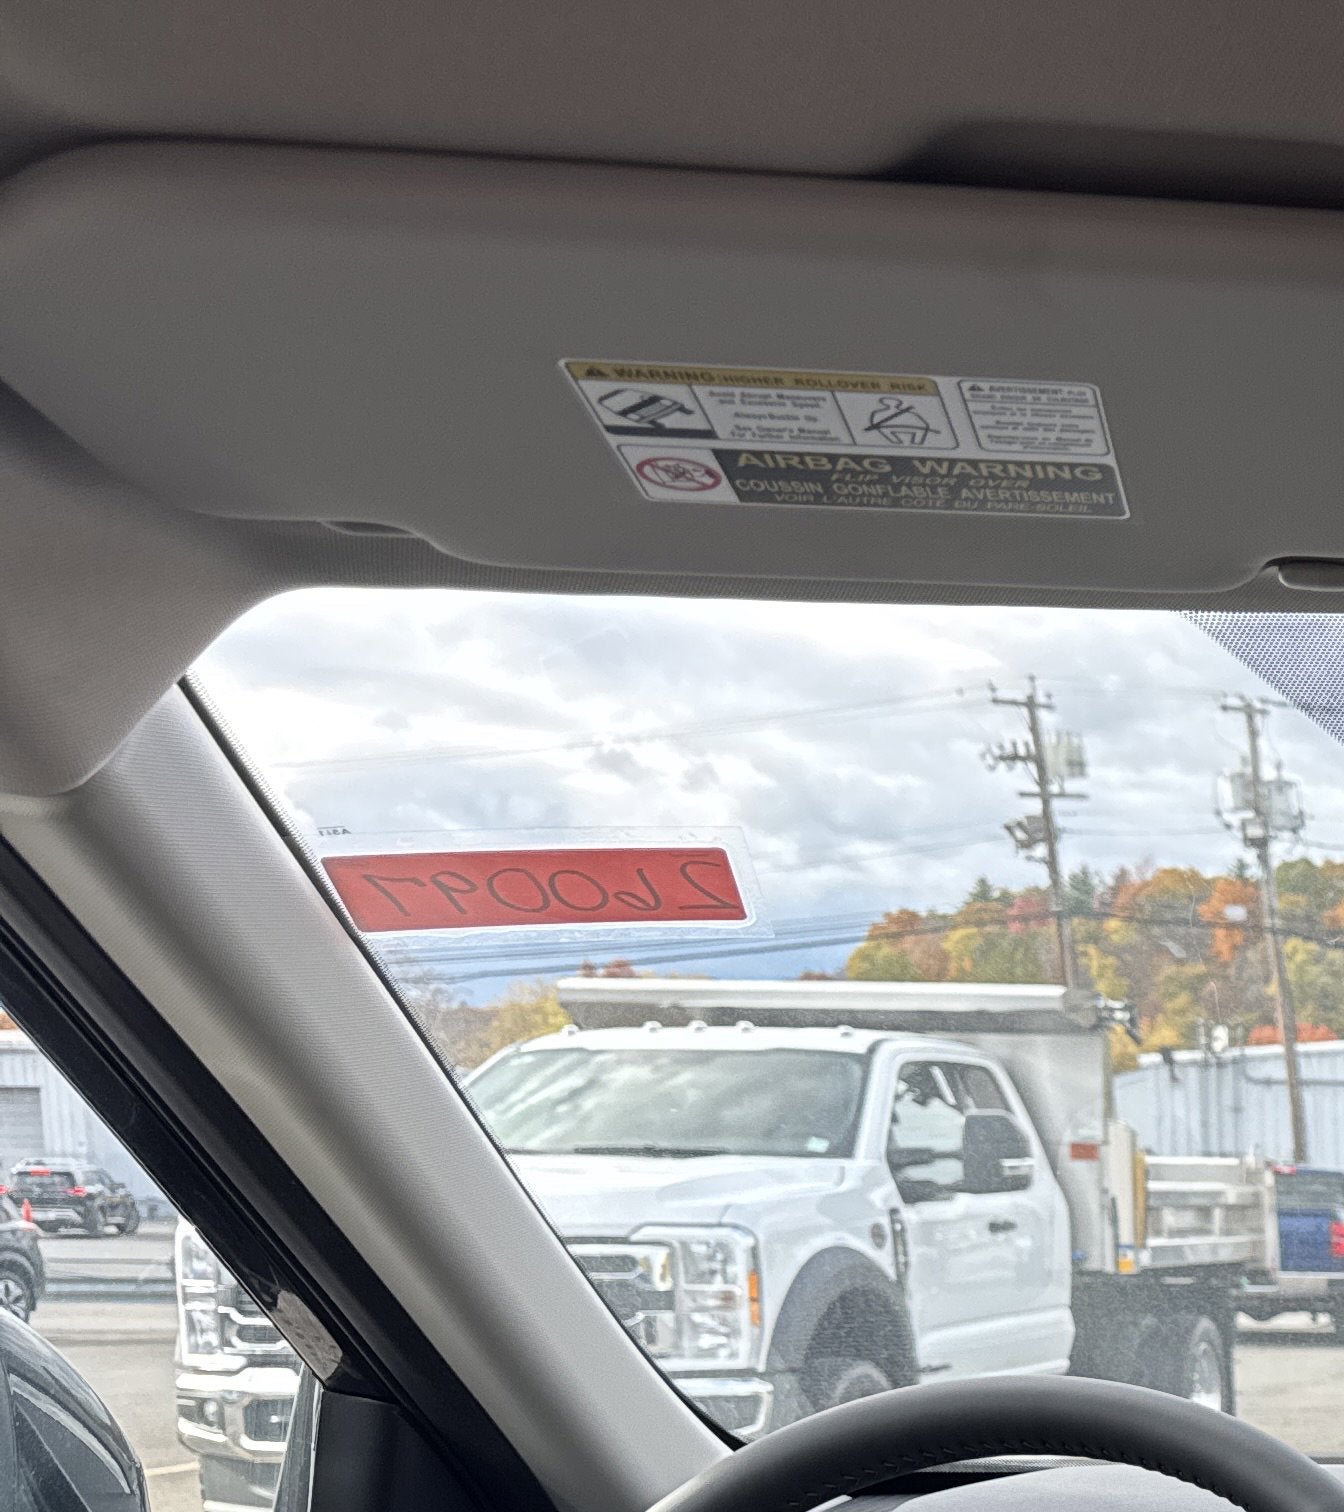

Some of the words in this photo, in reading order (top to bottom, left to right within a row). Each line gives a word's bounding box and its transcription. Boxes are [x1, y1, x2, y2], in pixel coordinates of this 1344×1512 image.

[737, 453, 892, 473] AIRBAG
[912, 460, 1103, 480] WARNING
[734, 479, 824, 494] COUSSIN
[832, 482, 951, 498] GONFLABLE
[960, 489, 1115, 504] AVERTISSEMENT
